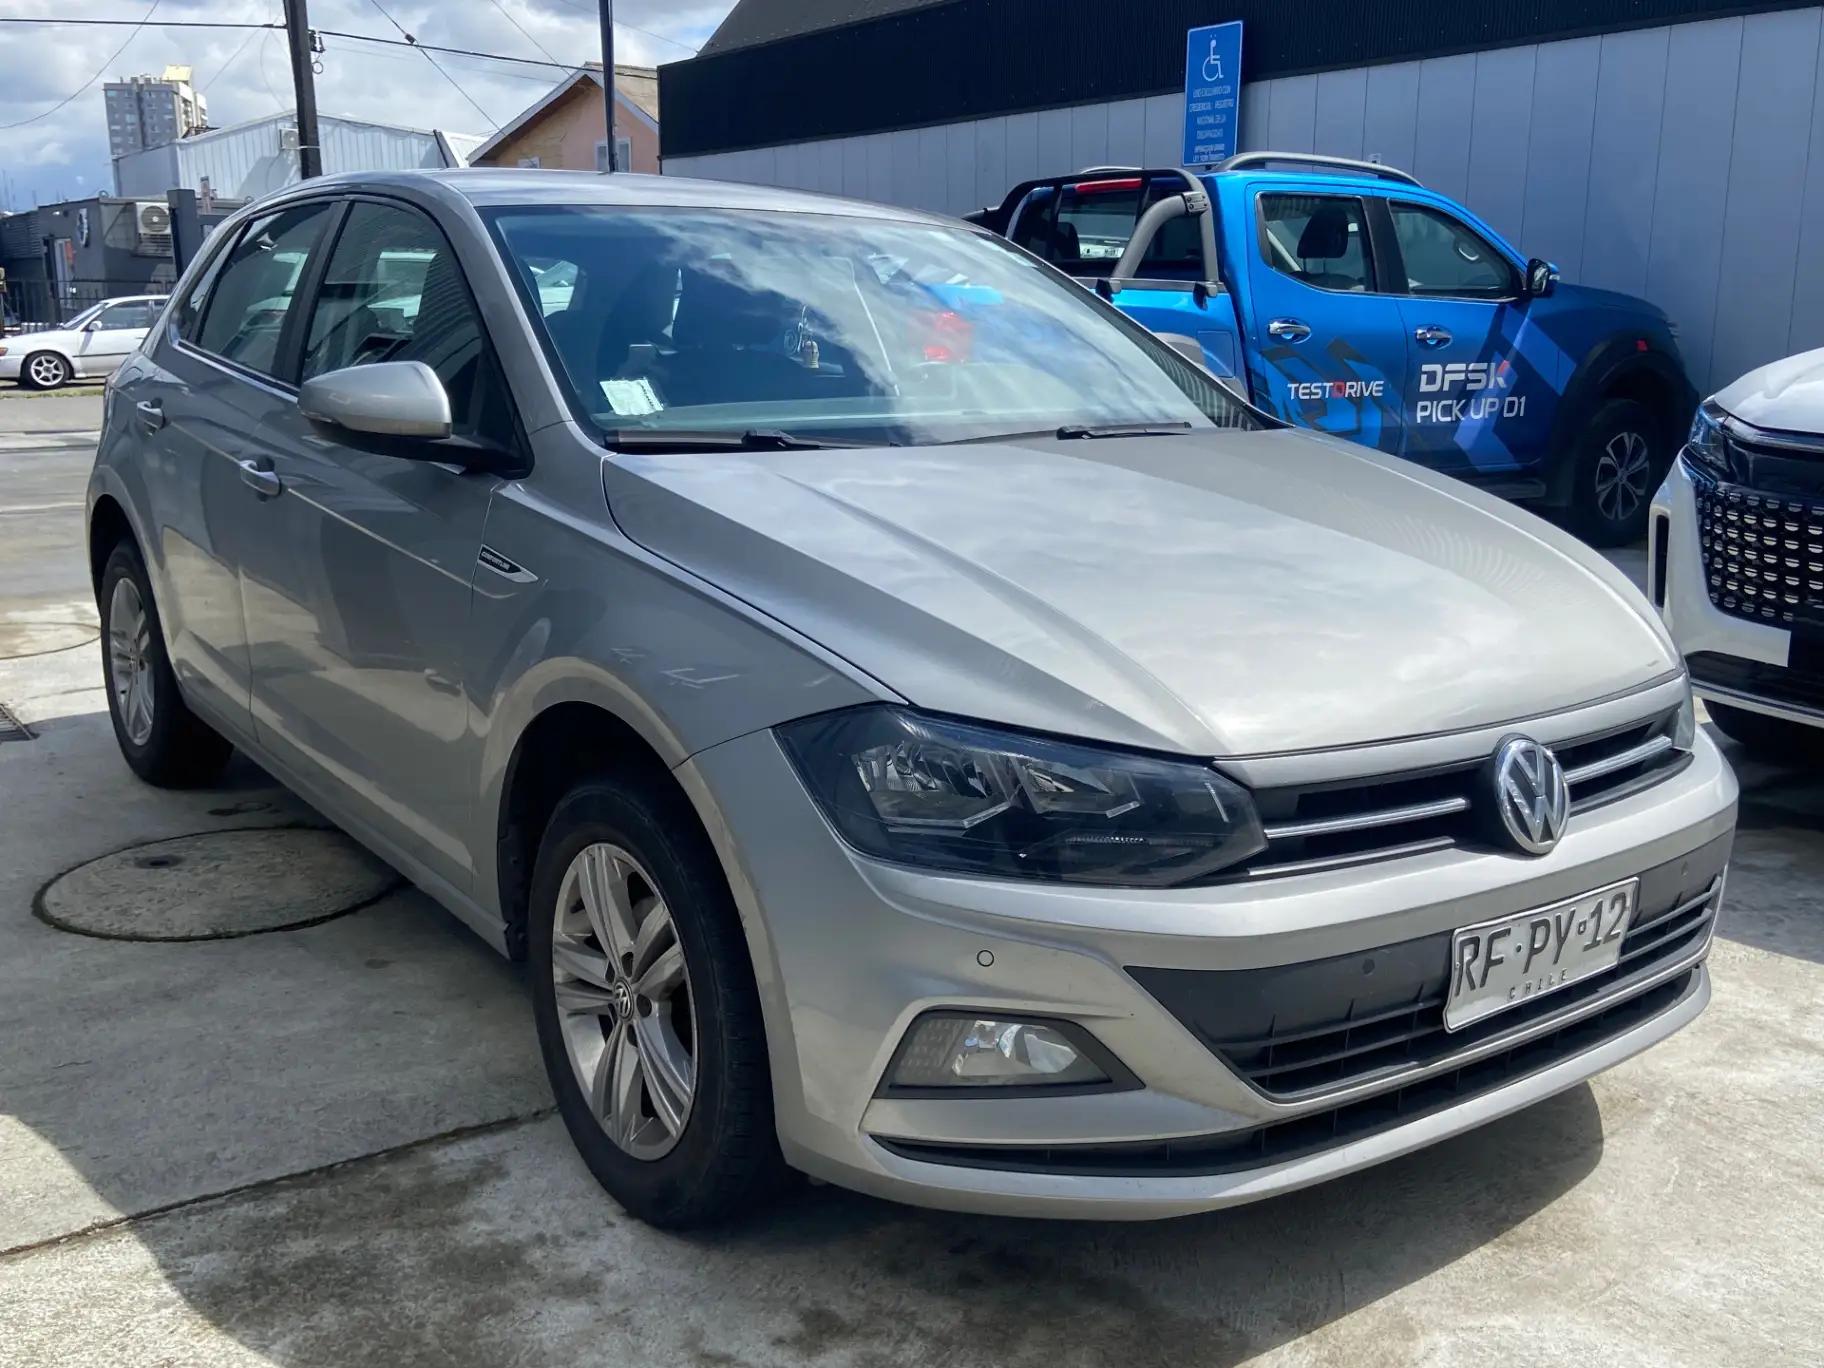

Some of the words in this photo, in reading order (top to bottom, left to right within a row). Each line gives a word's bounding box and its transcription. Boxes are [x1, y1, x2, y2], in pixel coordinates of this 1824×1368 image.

[1419, 360, 1511, 392] DFSK
[1416, 399, 1465, 423] PICK
[1470, 397, 1498, 420] UP
[1509, 968, 1568, 1000] CHILE
